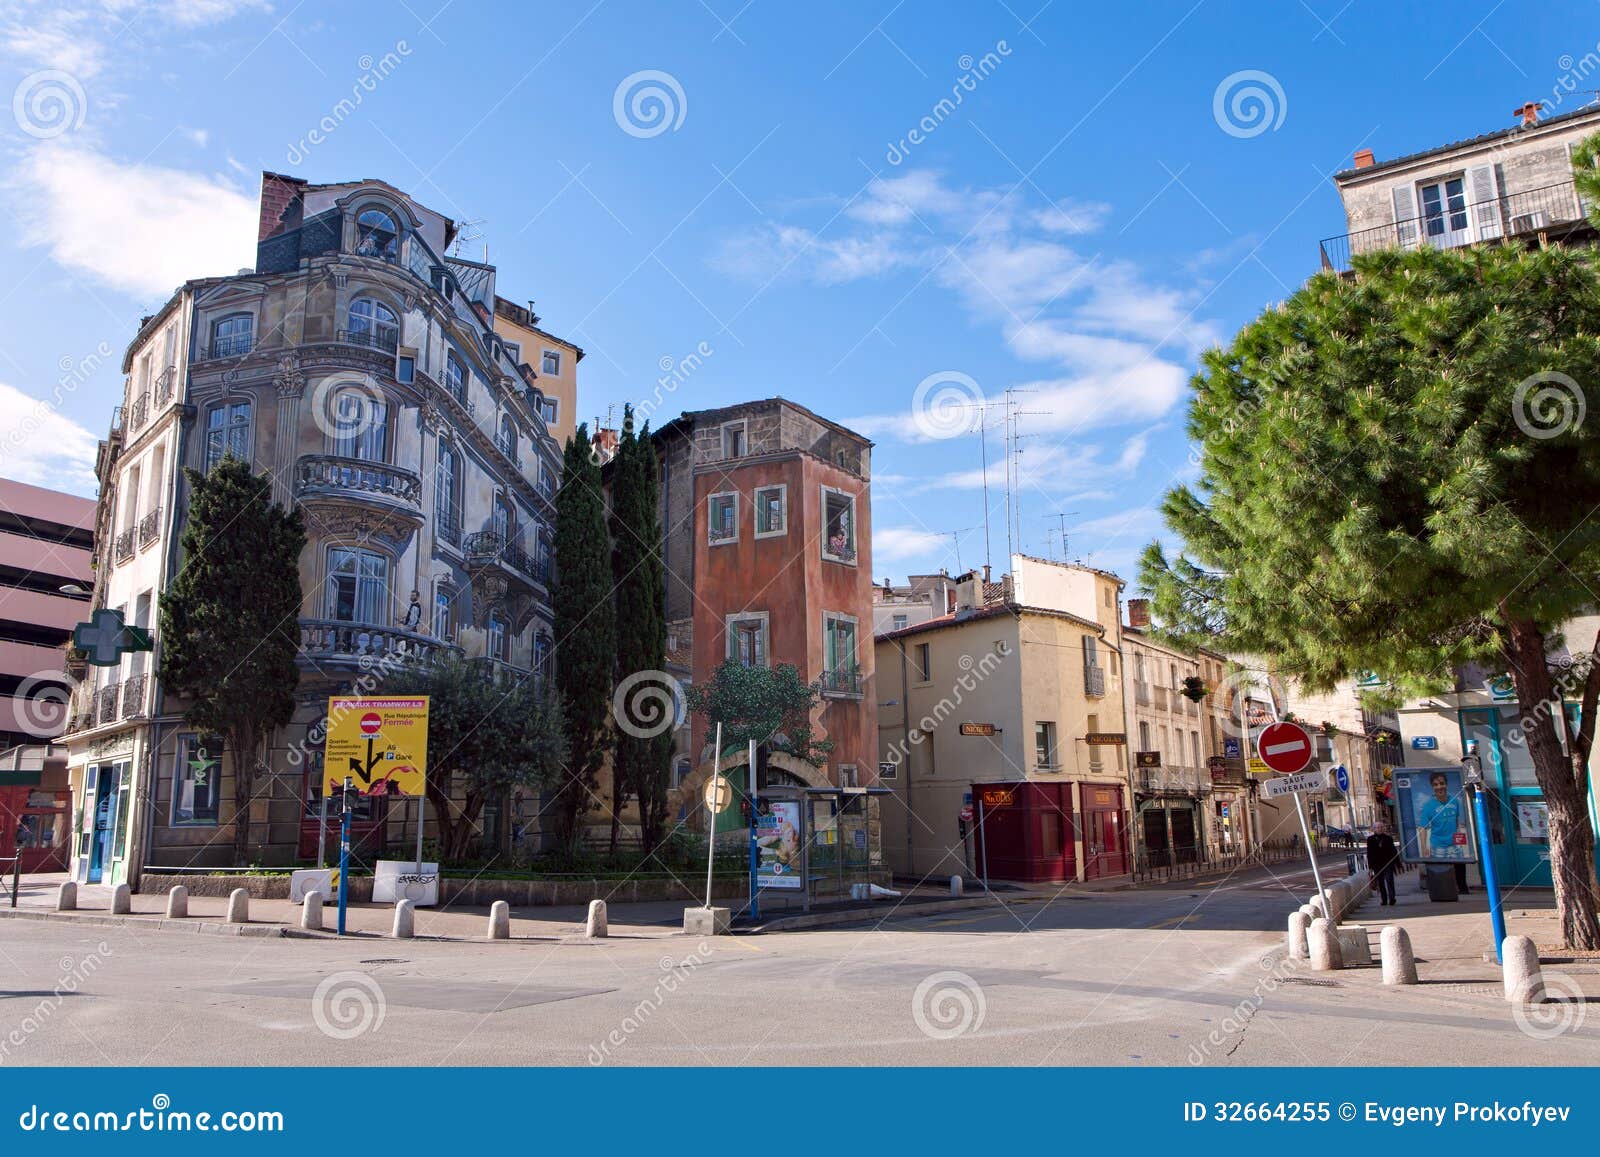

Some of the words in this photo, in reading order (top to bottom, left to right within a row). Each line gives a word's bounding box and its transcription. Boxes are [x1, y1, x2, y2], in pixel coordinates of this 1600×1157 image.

[335, 701, 370, 709] TRAVAUX
[373, 701, 411, 709] TRAMWAY
[1283, 775, 1305, 785] SAUF
[1273, 781, 1320, 794] RIVERAINS
